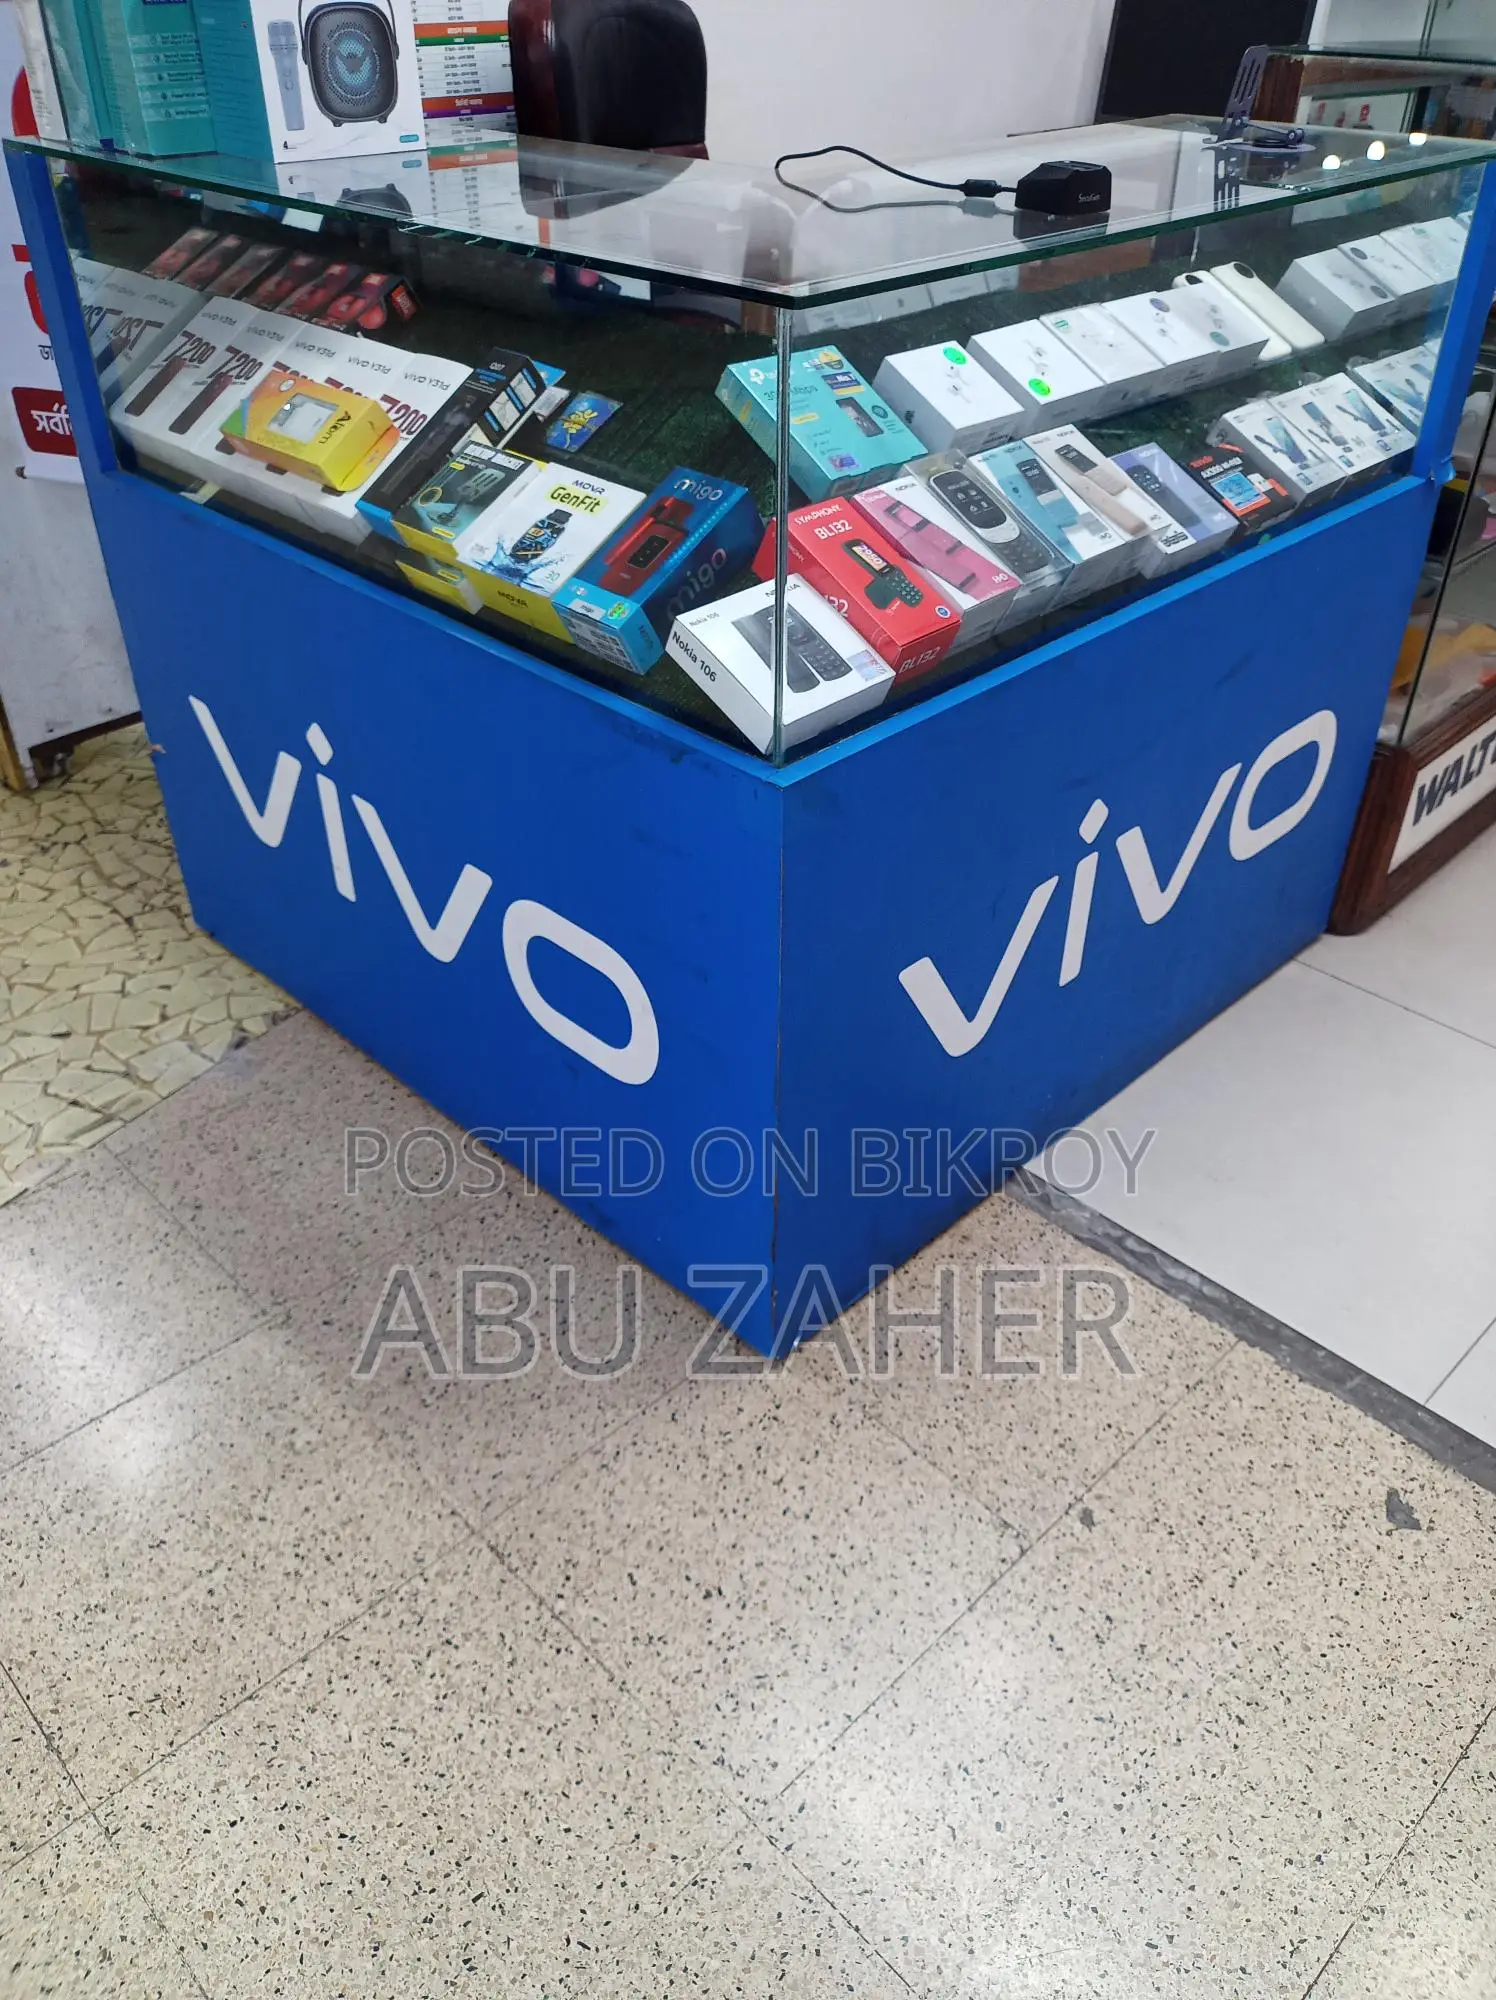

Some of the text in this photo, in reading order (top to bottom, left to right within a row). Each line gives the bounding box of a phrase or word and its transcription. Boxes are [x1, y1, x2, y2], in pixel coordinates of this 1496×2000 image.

[207, 345, 263, 380] 7200
[550, 486, 601, 513] GenFit
[673, 479, 723, 501] migo
[794, 504, 843, 526] SYMPHONY
[814, 519, 853, 540] BL132
[672, 631, 697, 664] Nokia
[700, 660, 717, 682] 106
[899, 646, 940, 674] BL132
[189, 695, 660, 1085] vivo
[899, 709, 1338, 1057] vivo
